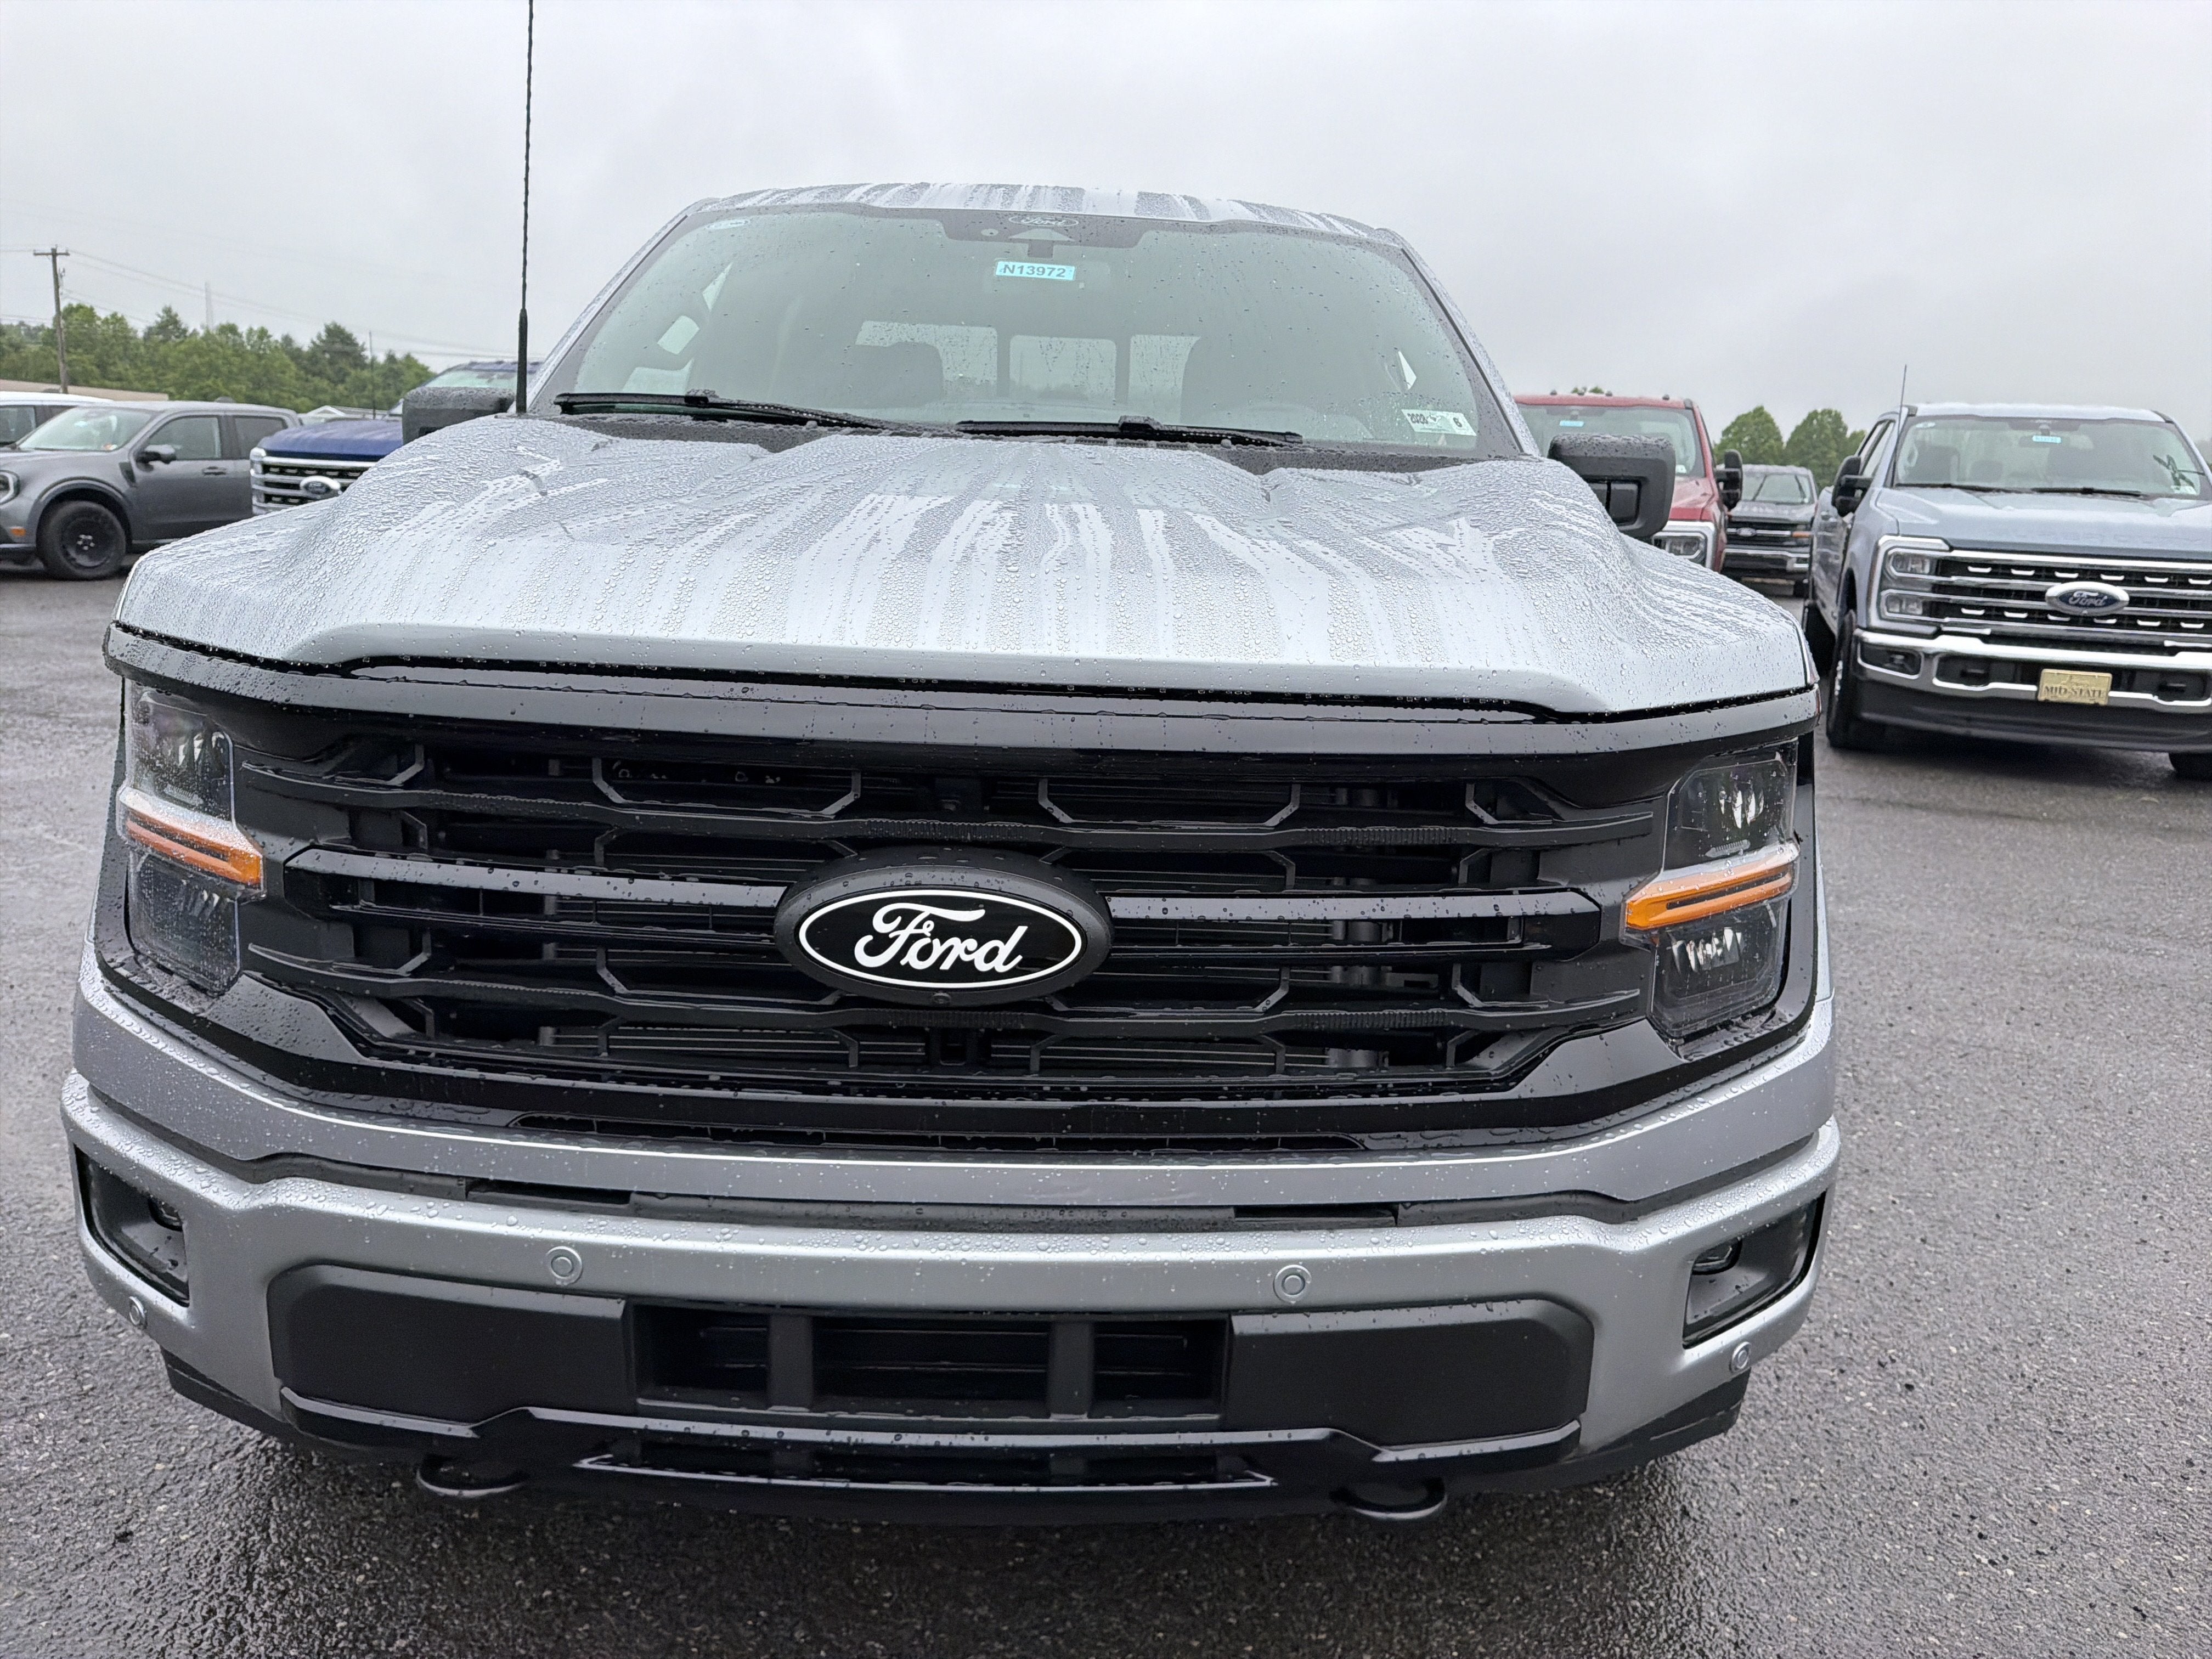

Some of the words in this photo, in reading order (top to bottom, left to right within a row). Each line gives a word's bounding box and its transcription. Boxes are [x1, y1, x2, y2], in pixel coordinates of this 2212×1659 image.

[1021, 216, 1066, 225] Ford
[1002, 264, 1066, 278] N13972
[2069, 591, 2107, 606] Ford
[854, 902, 1028, 973] Ford
